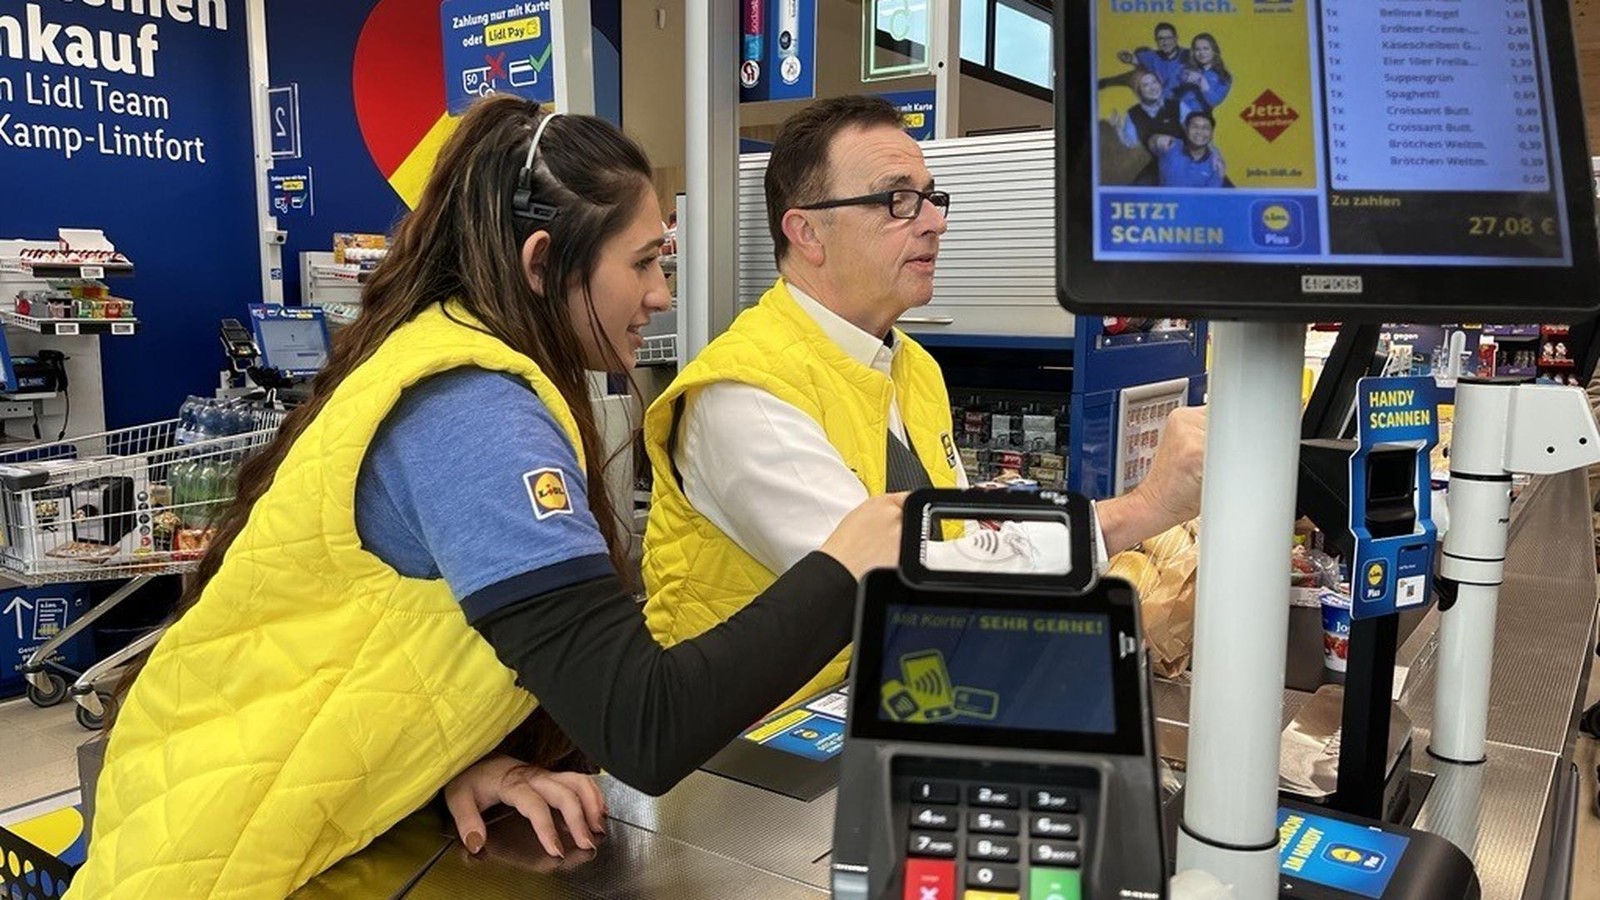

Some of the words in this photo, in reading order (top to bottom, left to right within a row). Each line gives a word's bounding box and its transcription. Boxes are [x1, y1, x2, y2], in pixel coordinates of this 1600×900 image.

[1110, 0, 1174, 13] lohnt
[452, 14, 489, 29] Zahlung
[490, 11, 506, 21] nur
[507, 7, 523, 18] mit
[524, 1, 550, 14] Karte
[1327, 25, 1339, 33] 1x
[0, 3, 158, 77] nkauf
[462, 34, 483, 47] oder
[488, 28, 506, 41] Lidl
[507, 27, 525, 39] Pay
[1328, 41, 1340, 49] 1x
[1329, 57, 1341, 65] 1x
[466, 73, 478, 86] 50
[1330, 73, 1341, 82] 1x
[26, 71, 83, 109] Lidl
[90, 80, 169, 119] Team
[1331, 90, 1343, 98] 1x
[1247, 104, 1289, 117] Jetzt
[1332, 106, 1344, 115] 1x
[1387, 106, 1441, 116] Croissant
[1333, 123, 1345, 131] 1x
[1388, 123, 1443, 132] Croissant
[0, 113, 206, 164] Kamp-Lintfort
[1334, 140, 1346, 148] 1x
[1335, 156, 1347, 165] 1x
[1332, 195, 1350, 206] Zu
[1353, 195, 1401, 206] zahlen
[1110, 202, 1178, 220] JETZT
[1469, 216, 1533, 236] 27,08
[1541, 218, 1556, 235] €
[1111, 226, 1224, 244] SCANNEN
[1265, 233, 1289, 244] Plus
[1369, 389, 1415, 408] HANDY
[1370, 409, 1431, 430] SCANNEN
[979, 615, 1028, 631] SEHR
[1033, 617, 1103, 635] GERNE!
